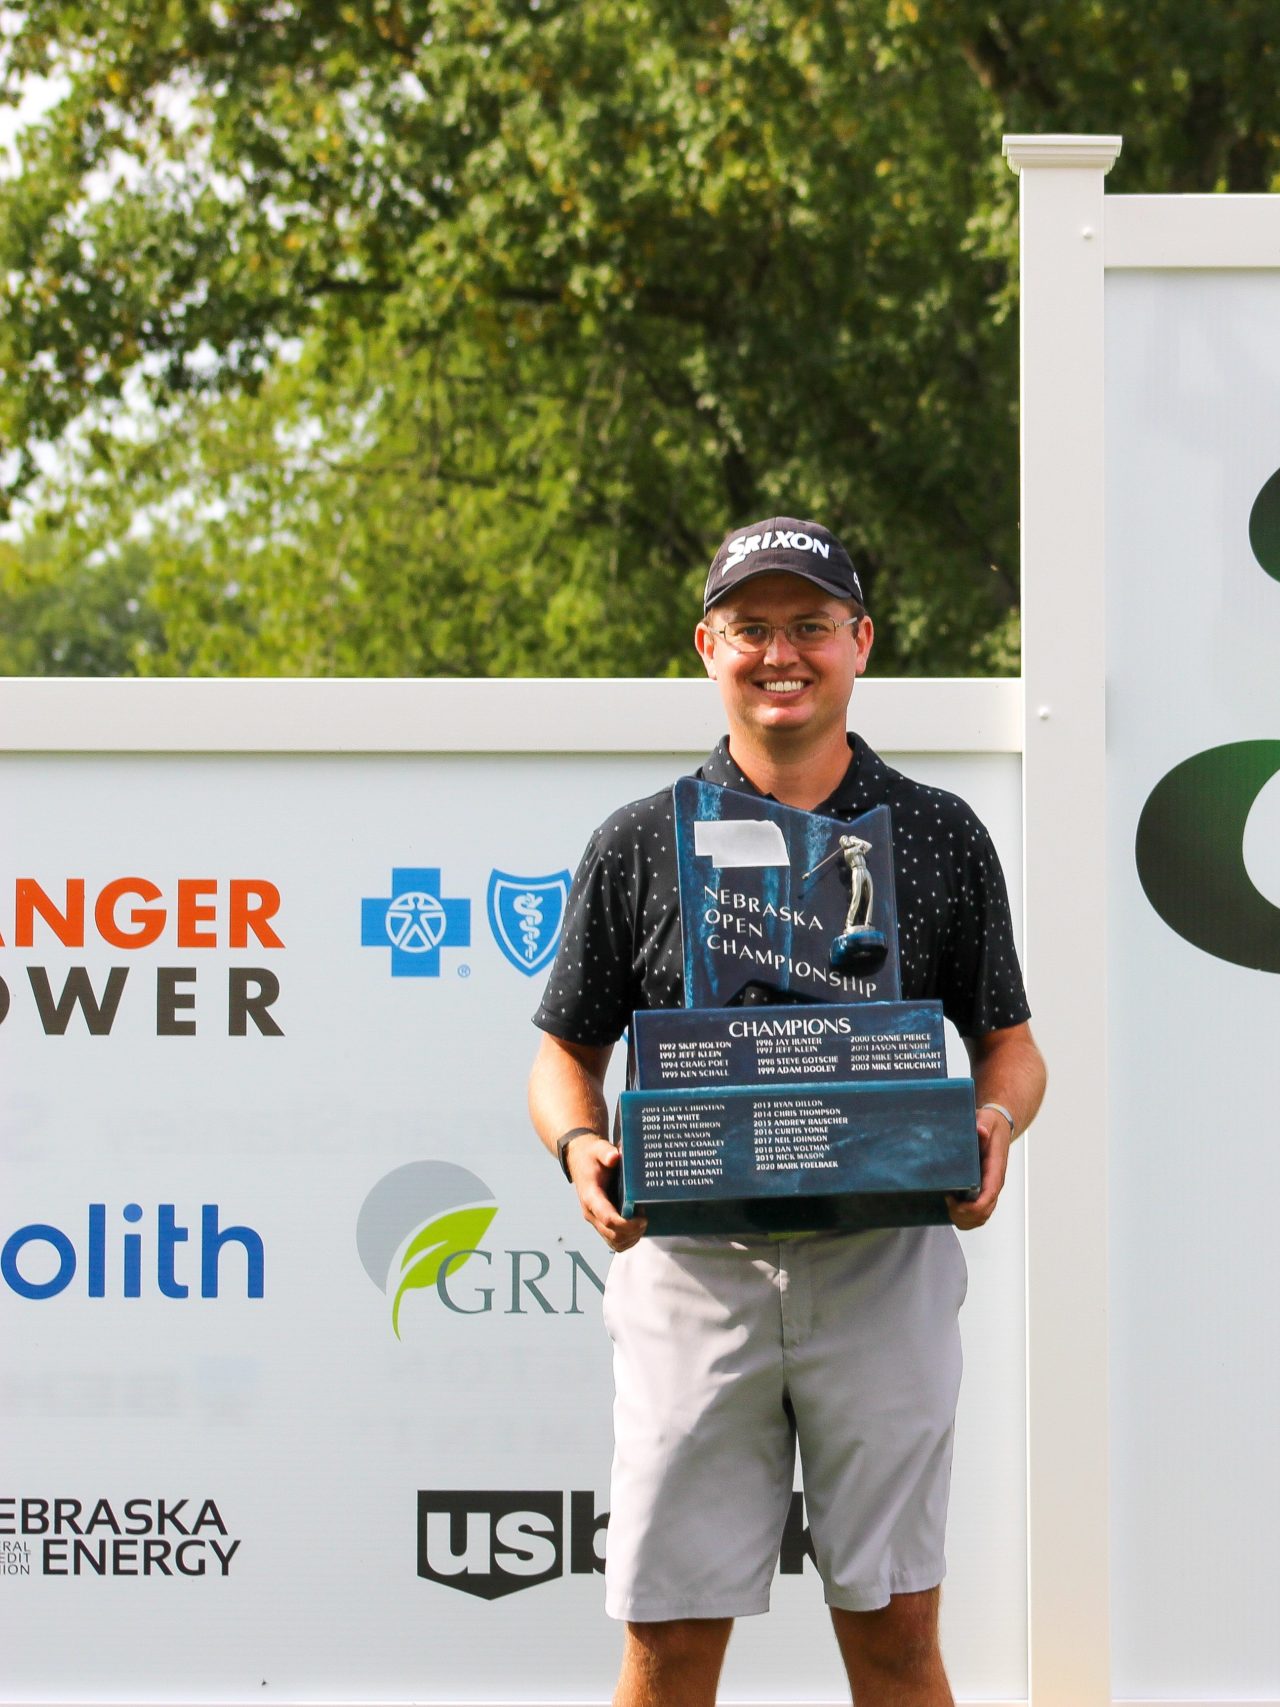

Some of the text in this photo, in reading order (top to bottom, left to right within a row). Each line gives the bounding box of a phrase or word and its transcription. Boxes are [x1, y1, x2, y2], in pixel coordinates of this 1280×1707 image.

[722, 530, 830, 577] SRIXON
[0, 876, 286, 949] NGER
[704, 885, 824, 931] NEBRASKA
[704, 908, 763, 938] OPEN
[706, 934, 878, 998] CHAMPIONSHIP
[0, 966, 286, 1036] WER
[728, 1017, 851, 1038] CHAMPIONS
[776, 1038, 789, 1046] JAY
[791, 1037, 822, 1045] HUNTER
[850, 1032, 932, 1043] 2000 CONNIE PIERCE
[659, 1041, 732, 1051] 1992 SKIP HOLTON
[851, 1044, 869, 1052] 2001
[871, 1044, 897, 1052] JASON
[660, 1051, 676, 1059] 1993
[698, 1050, 722, 1058] KLEIN
[851, 1051, 941, 1062] 2002 MIKE SCHUCHART
[660, 1061, 678, 1069] 1994
[680, 1060, 707, 1068] CRAIG
[758, 1055, 839, 1066] 1998 STEVE GOTSCHE
[758, 1064, 836, 1075] 1999 ADAM DOOLEY
[871, 1062, 891, 1071] MIKE
[893, 1061, 941, 1070] SCHUCHART
[680, 1070, 697, 1078] KEN
[699, 1069, 729, 1077] SCHALL
[795, 1100, 823, 1108] DILLON
[799, 1108, 841, 1117] THOMPSON
[642, 1113, 700, 1123] 2005 JIM WHITE
[808, 1116, 848, 1125] RAUSCHER
[642, 1121, 721, 1131] 2006 JUSTIN HERRON
[754, 1126, 829, 1136] 2016 CURTIS YONKE
[663, 1132, 682, 1140] NICK
[754, 1137, 772, 1145] 2017
[792, 1135, 828, 1143] JOHNSON
[664, 1141, 688, 1149] KENNY
[754, 1146, 773, 1154] 2018
[793, 1144, 830, 1152] WOLTMAN
[688, 1149, 717, 1157] BISHOP
[755, 1152, 824, 1162] 2019 NICK MASON
[665, 1160, 688, 1168] PETER
[690, 1158, 723, 1166] MALNATI
[756, 1163, 775, 1171] 2020
[776, 1162, 798, 1170] MARK
[645, 1168, 723, 1178] 2011 PETER MALNATI
[682, 1178, 714, 1186] COLLINS
[0, 1203, 264, 1300] olith
[0, 1498, 229, 1536] EBRASKA
[0, 1541, 31, 1552] RAL
[43, 1539, 241, 1576] ENERGY
[0, 1564, 30, 1575] ION
